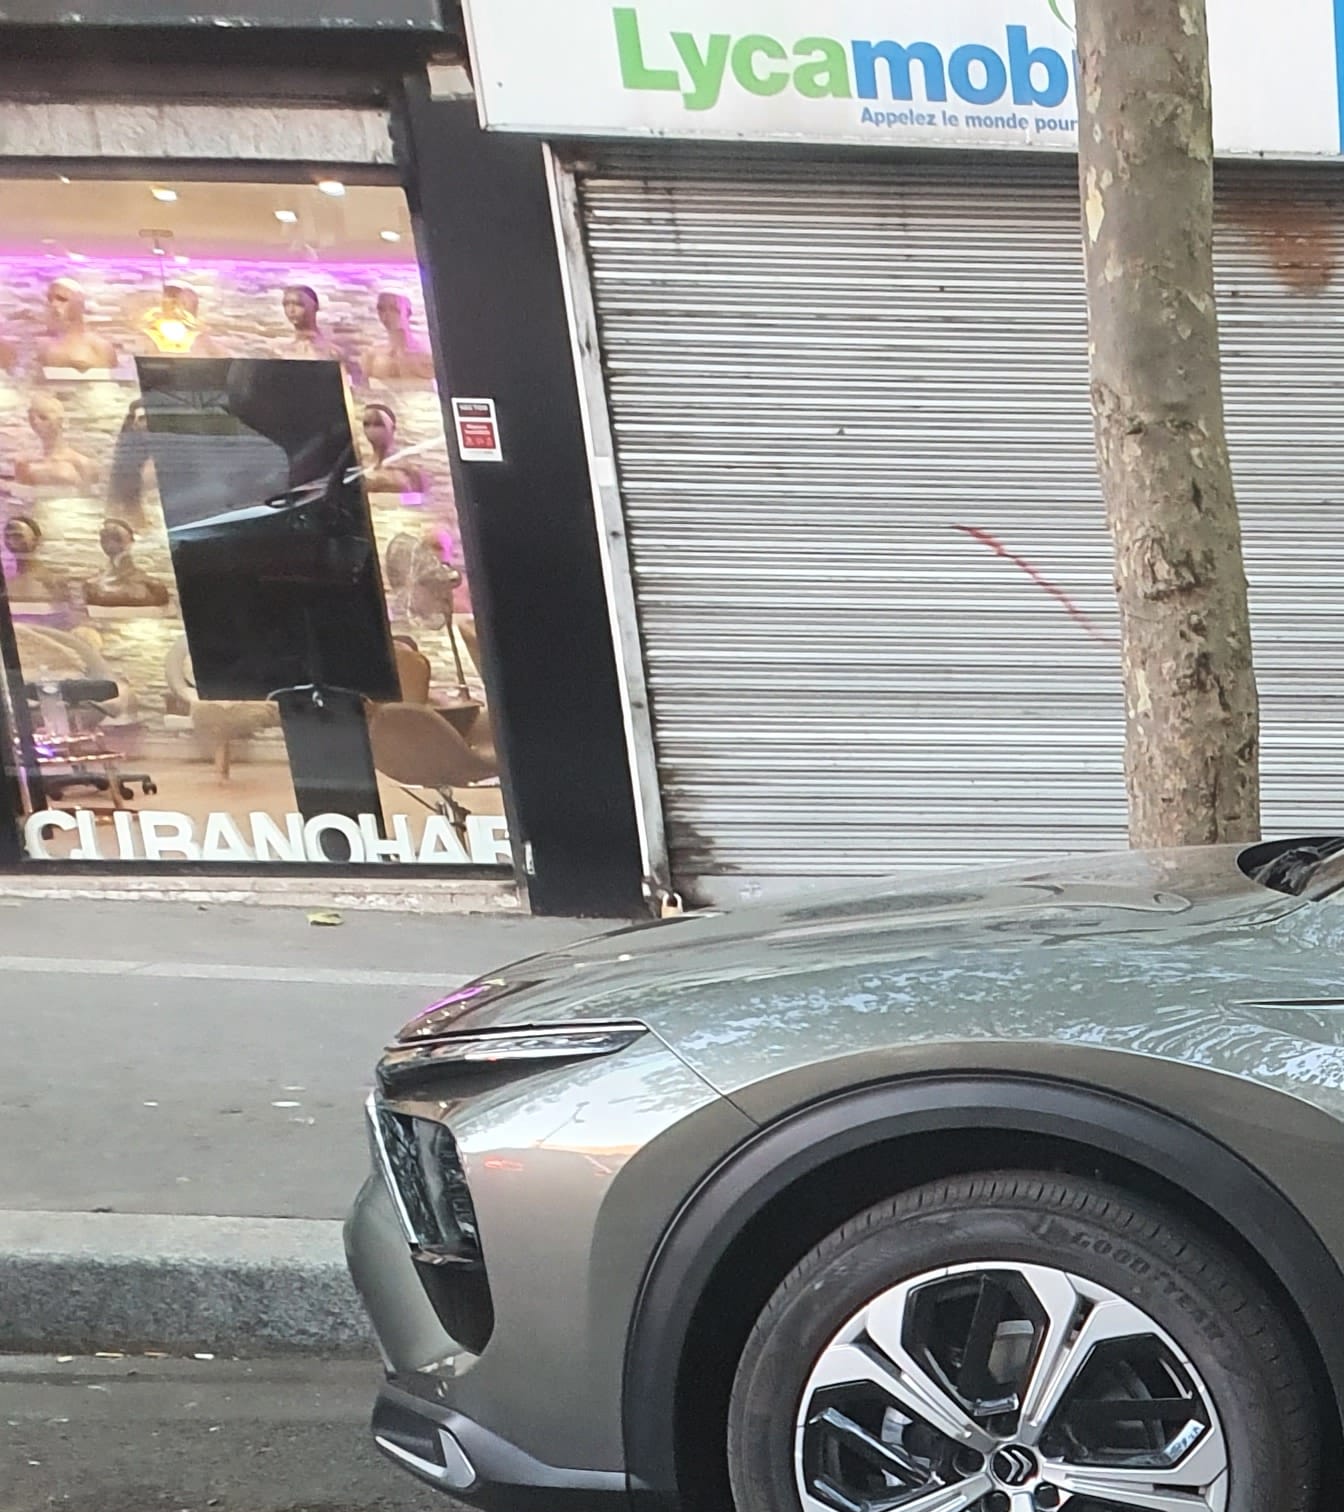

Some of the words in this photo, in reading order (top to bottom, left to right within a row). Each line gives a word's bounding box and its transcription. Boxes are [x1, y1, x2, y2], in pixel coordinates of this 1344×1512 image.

[612, 7, 1078, 111] Lycamob
[861, 107, 937, 128] Appelez
[943, 109, 959, 127] le
[965, 113, 1029, 131] monde
[1035, 117, 1077, 134] pour
